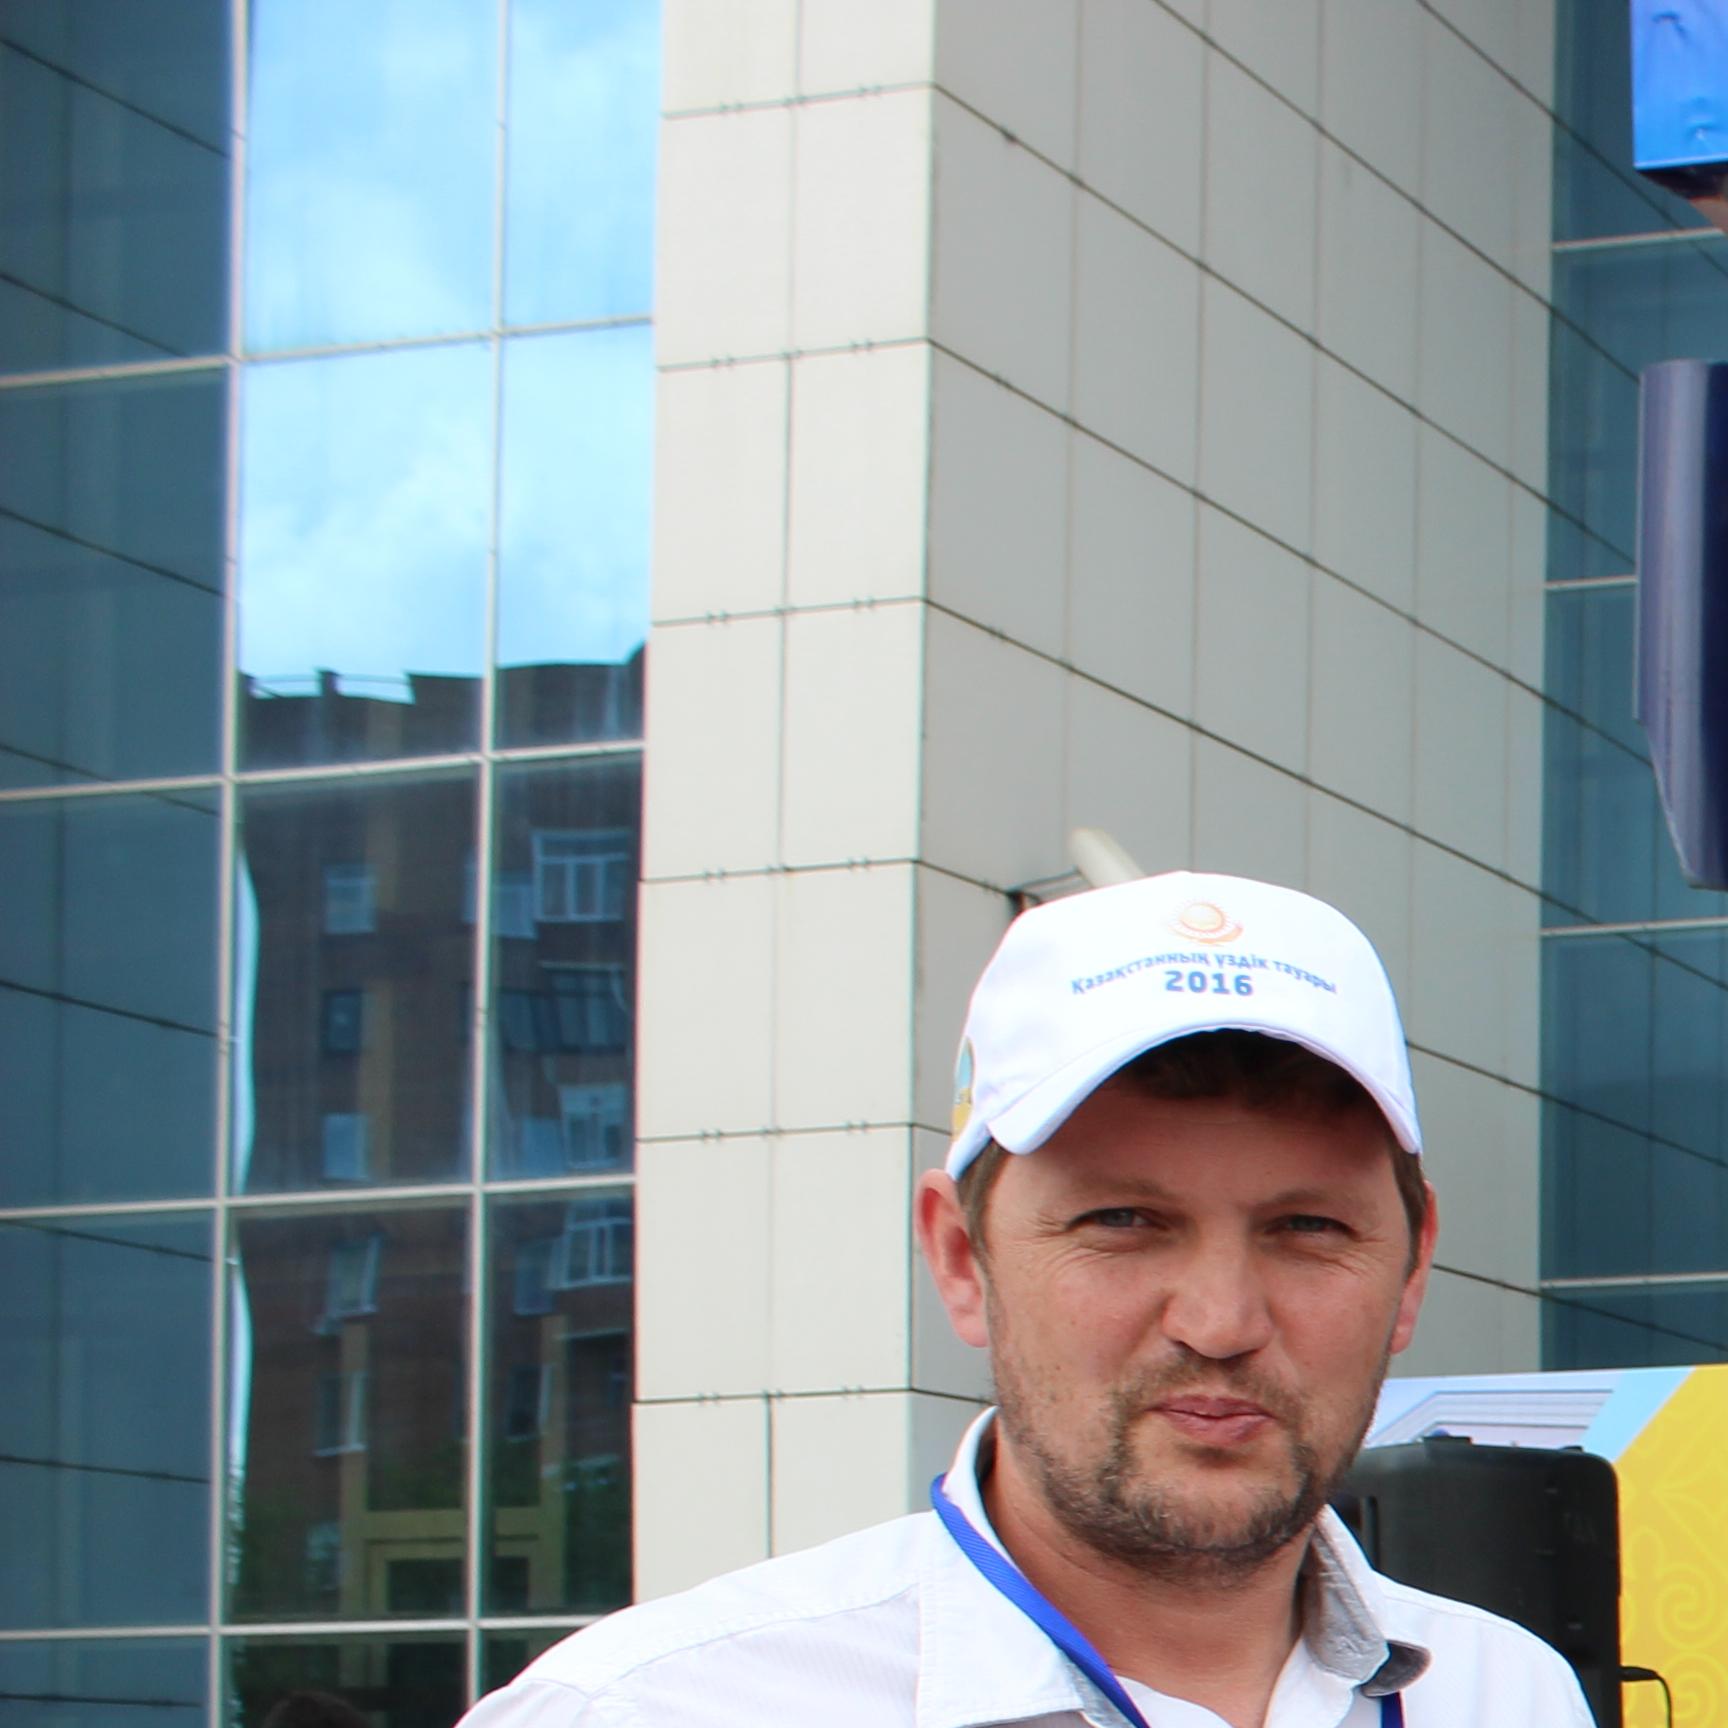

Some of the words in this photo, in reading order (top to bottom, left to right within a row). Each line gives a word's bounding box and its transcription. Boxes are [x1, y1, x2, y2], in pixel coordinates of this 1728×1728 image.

[1165, 969, 1255, 997] 2016
[1214, 953, 1268, 970] үздік
[1273, 960, 1338, 995] тауары
